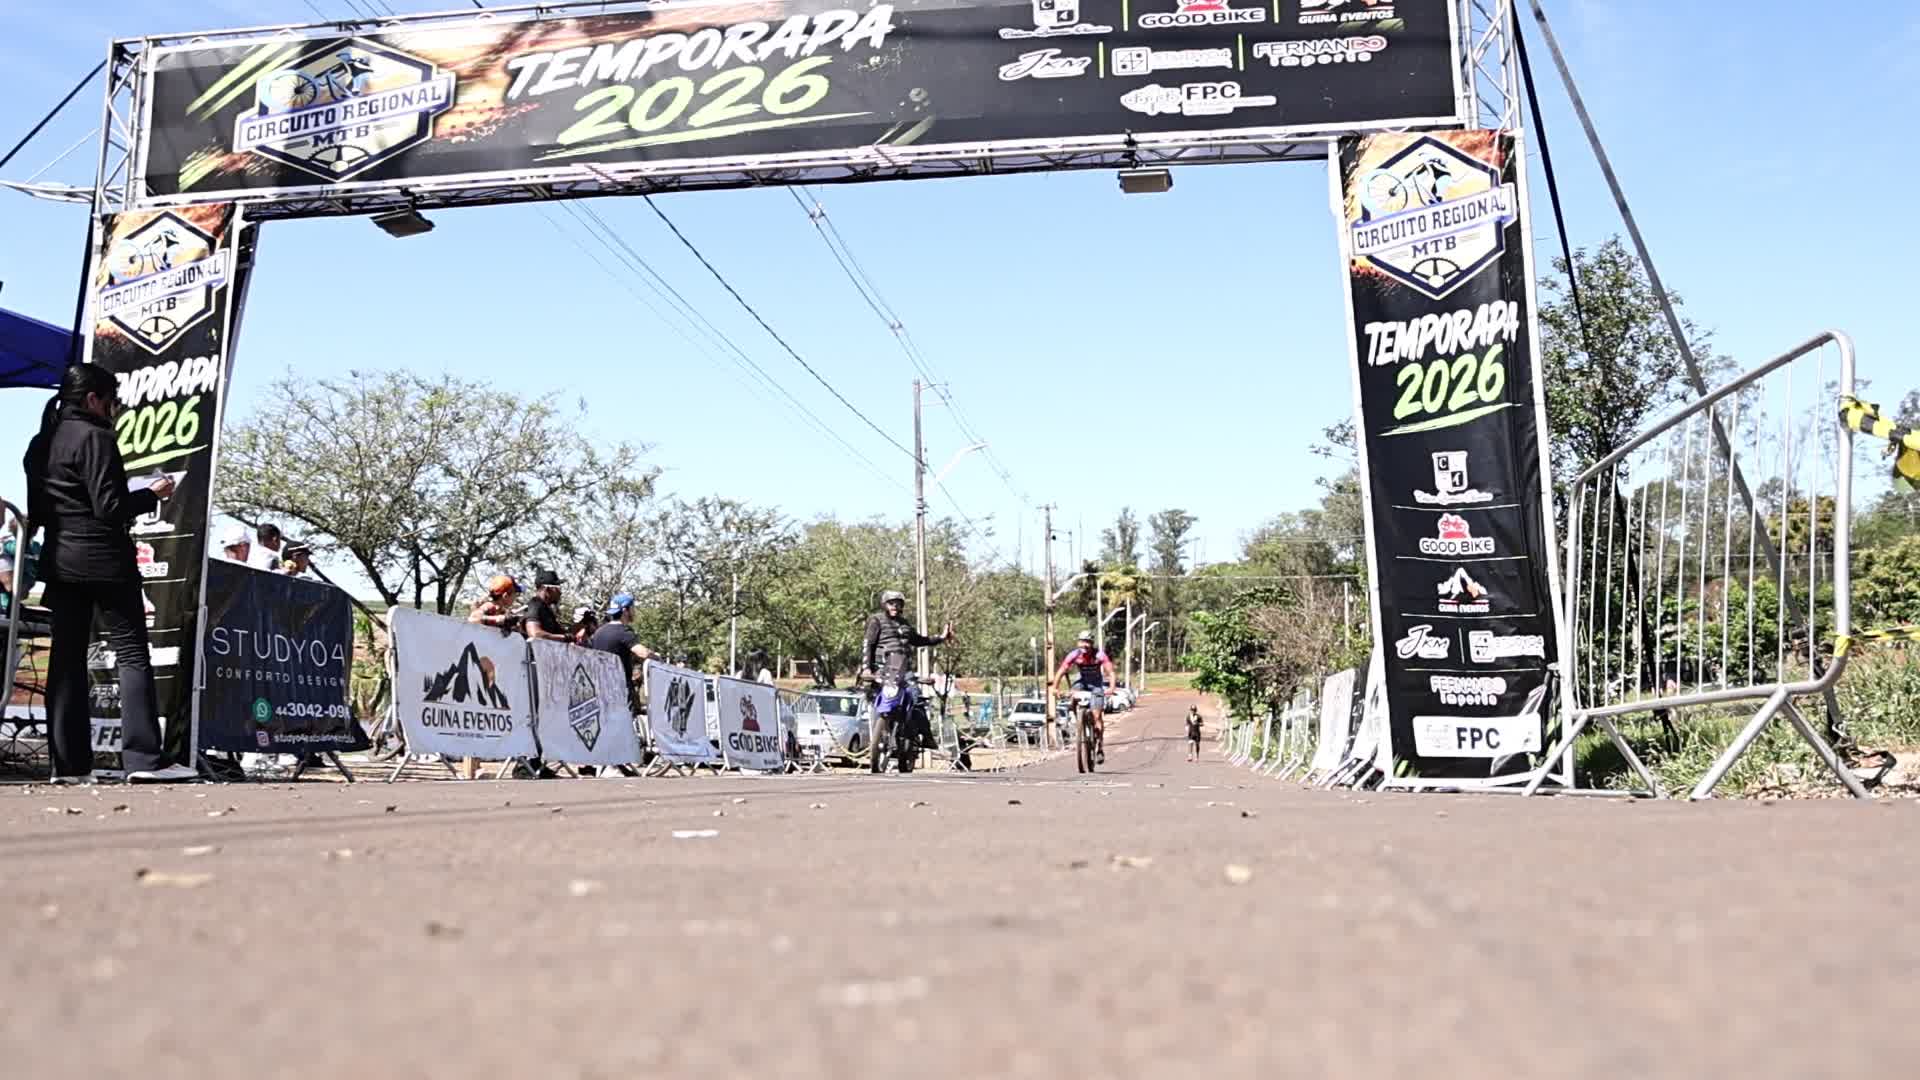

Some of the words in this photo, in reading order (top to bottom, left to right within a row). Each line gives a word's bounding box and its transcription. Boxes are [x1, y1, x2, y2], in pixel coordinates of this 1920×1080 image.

[1142, 14, 1207, 26] GOOD
[1213, 9, 1261, 22] BIKE
[1299, 13, 1337, 24] GUINA
[1341, 10, 1394, 21] EVENTOS
[1255, 38, 1384, 56] FERNANDO
[247, 110, 336, 141] CIRCUITO
[342, 85, 441, 122] REGIONAL
[556, 56, 833, 146] 2026
[312, 124, 370, 148] MTB
[1357, 214, 1427, 249] CIRCUITO
[1432, 194, 1507, 230] REGIONAL
[1411, 235, 1457, 259] MTB
[103, 280, 157, 312] CIRCUITO
[160, 257, 221, 290] REGIONAL
[141, 296, 177, 316] MTB
[1393, 342, 1505, 420] 2026
[115, 395, 200, 456] 2026
[1421, 540, 1457, 553] GOOD
[1460, 539, 1493, 553] BIKE
[216, 667, 290, 683] CONFORTO
[422, 707, 460, 728] GUINA
[463, 711, 512, 732] EVENTOS
[1456, 727, 1500, 749] FPC
